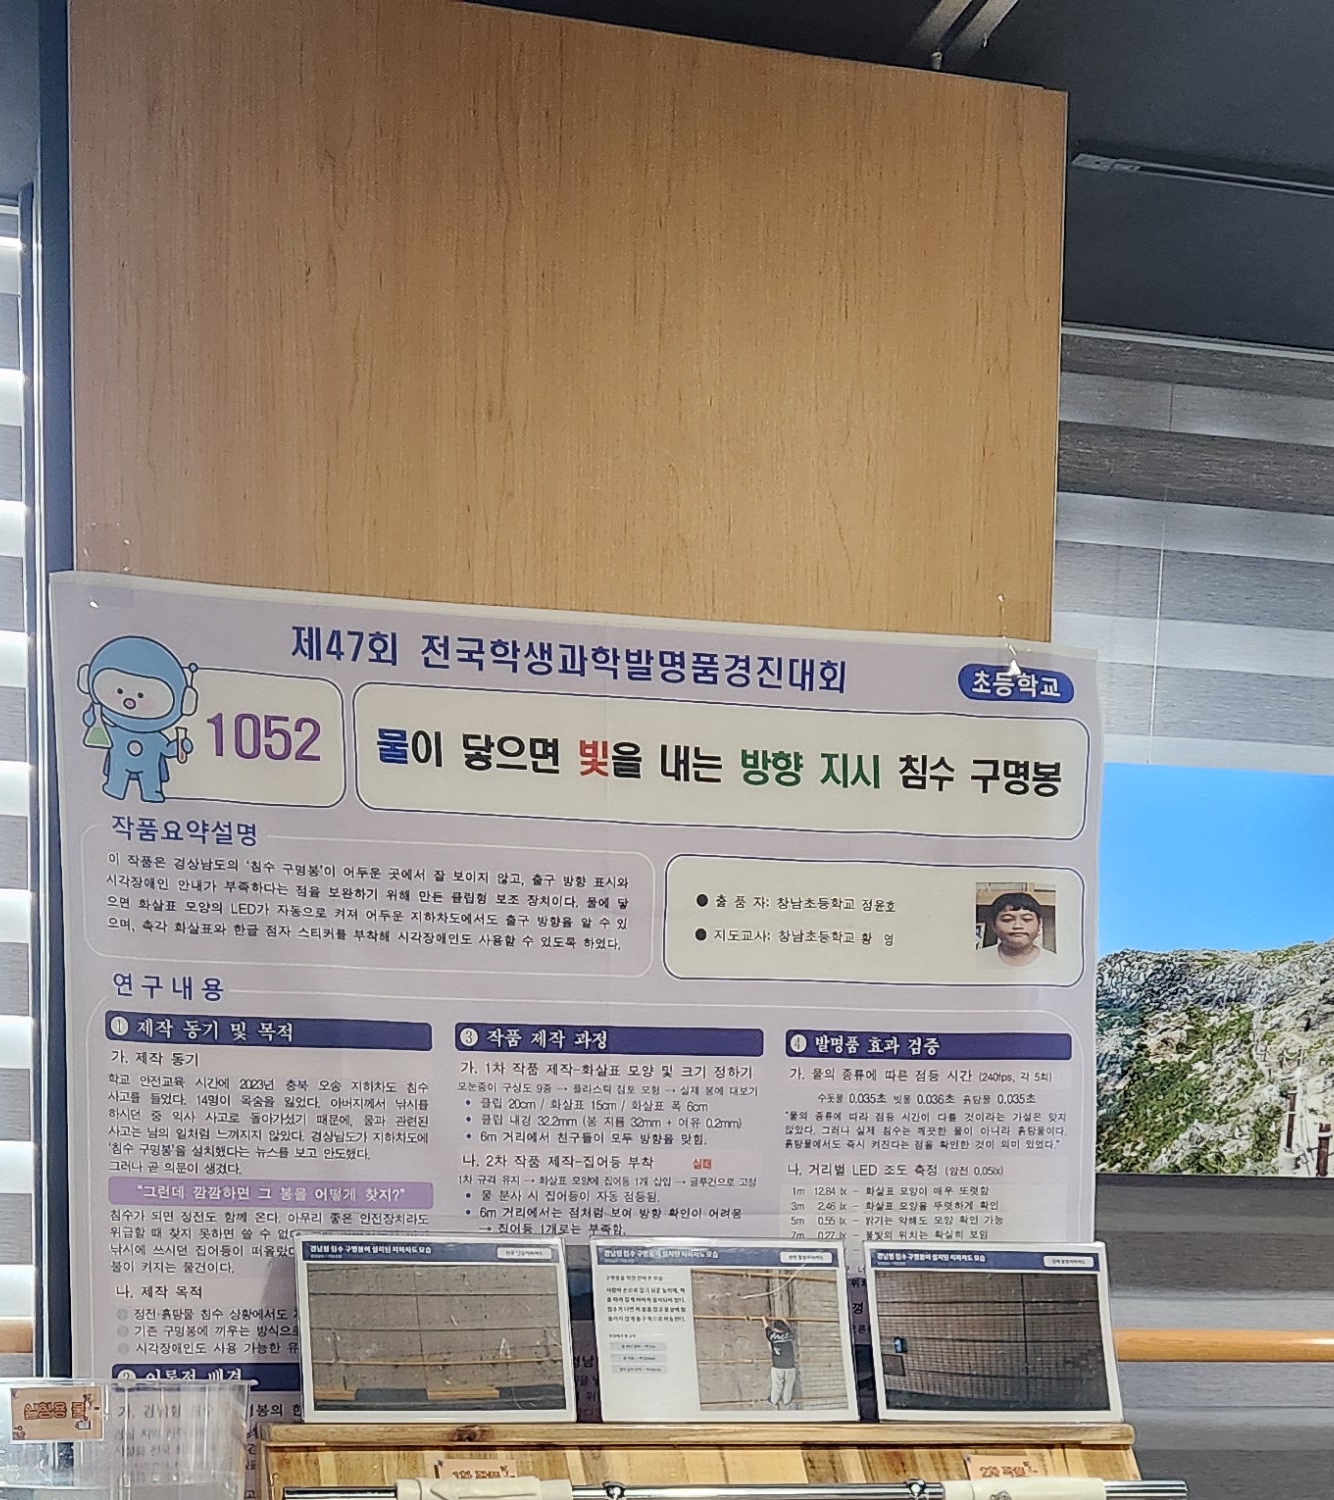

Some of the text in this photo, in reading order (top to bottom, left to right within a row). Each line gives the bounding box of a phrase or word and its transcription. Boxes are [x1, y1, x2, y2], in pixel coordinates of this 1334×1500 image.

[291, 625, 846, 694] 제47회 전국학생과학발명품경진대회
[970, 668, 1061, 698] 초등학교
[206, 712, 321, 762] 1052
[376, 728, 1062, 797] 물이 닿으면 빛을 내는 방향 지시 침수 구명봉
[111, 815, 257, 846] 작품요약설명
[109, 852, 119, 865] 이
[127, 855, 166, 869] 작품은
[174, 857, 238, 871] 경상남도의
[343, 866, 381, 880] 어두운
[388, 868, 425, 881] 곳에서
[434, 870, 446, 882] 잘
[452, 870, 488, 884] 보이지
[497, 872, 524, 887] 않고,
[532, 873, 556, 887] 출구
[563, 875, 586, 888] 방향
[593, 876, 629, 889] 표시와
[106, 874, 168, 891] 시각장애인
[178, 879, 217, 893] 안내가
[328, 887, 377, 901] 보완하기
[386, 889, 410, 902] 위해
[419, 890, 444, 903] 만든
[495, 893, 519, 905] 보조
[527, 894, 579, 908] 장치이다.
[617, 898, 629, 910] 닿
[107, 896, 130, 909] 으면
[185, 901, 222, 914] 모양의
[231, 902, 270, 916] LED가
[277, 904, 327, 918] 자동으로
[335, 907, 358, 921] 켜져
[366, 909, 404, 922] 어두운
[411, 910, 498, 925] 지하차도에서도
[505, 914, 529, 927] 출구
[537, 915, 573, 928] 방향을
[599, 917, 610, 929] 수
[617, 917, 627, 930] 있
[108, 917, 621, 951] 으며, 촉각 화살표와 한글 점자 스티커를 부착해 시각장애인도 사용할 수 있도록 하였다.
[137, 1018, 292, 1042] 제작 동기 및 목적
[487, 1028, 607, 1050] 작품 제작 과정
[815, 1034, 940, 1055] 발명품 효과 검증
[111, 1049, 198, 1067] 가. 제작 동기
[461, 1060, 752, 1079] 가. 1차 작품 제작-화살표 모양 및 크기 정하기
[790, 1067, 805, 1080] 가.
[812, 1067, 835, 1081] 물의
[885, 1069, 909, 1082] 따른
[915, 1069, 939, 1082] 점등
[947, 1069, 973, 1082] 시간
[463, 1153, 654, 1169] 나. 2차 작품 제작-집어등 부착
[788, 1163, 802, 1176] 나.
[808, 1163, 845, 1176] 거리별
[852, 1164, 878, 1176] LED
[884, 1164, 907, 1176] 조도
[193, 1185, 250, 1201] 깜깜하면
[257, 1188, 272, 1199] 그
[280, 1187, 307, 1201] 봉을
[315, 1187, 355, 1202] 어떻게
[116, 1284, 202, 1299] 나. 제작 목적
